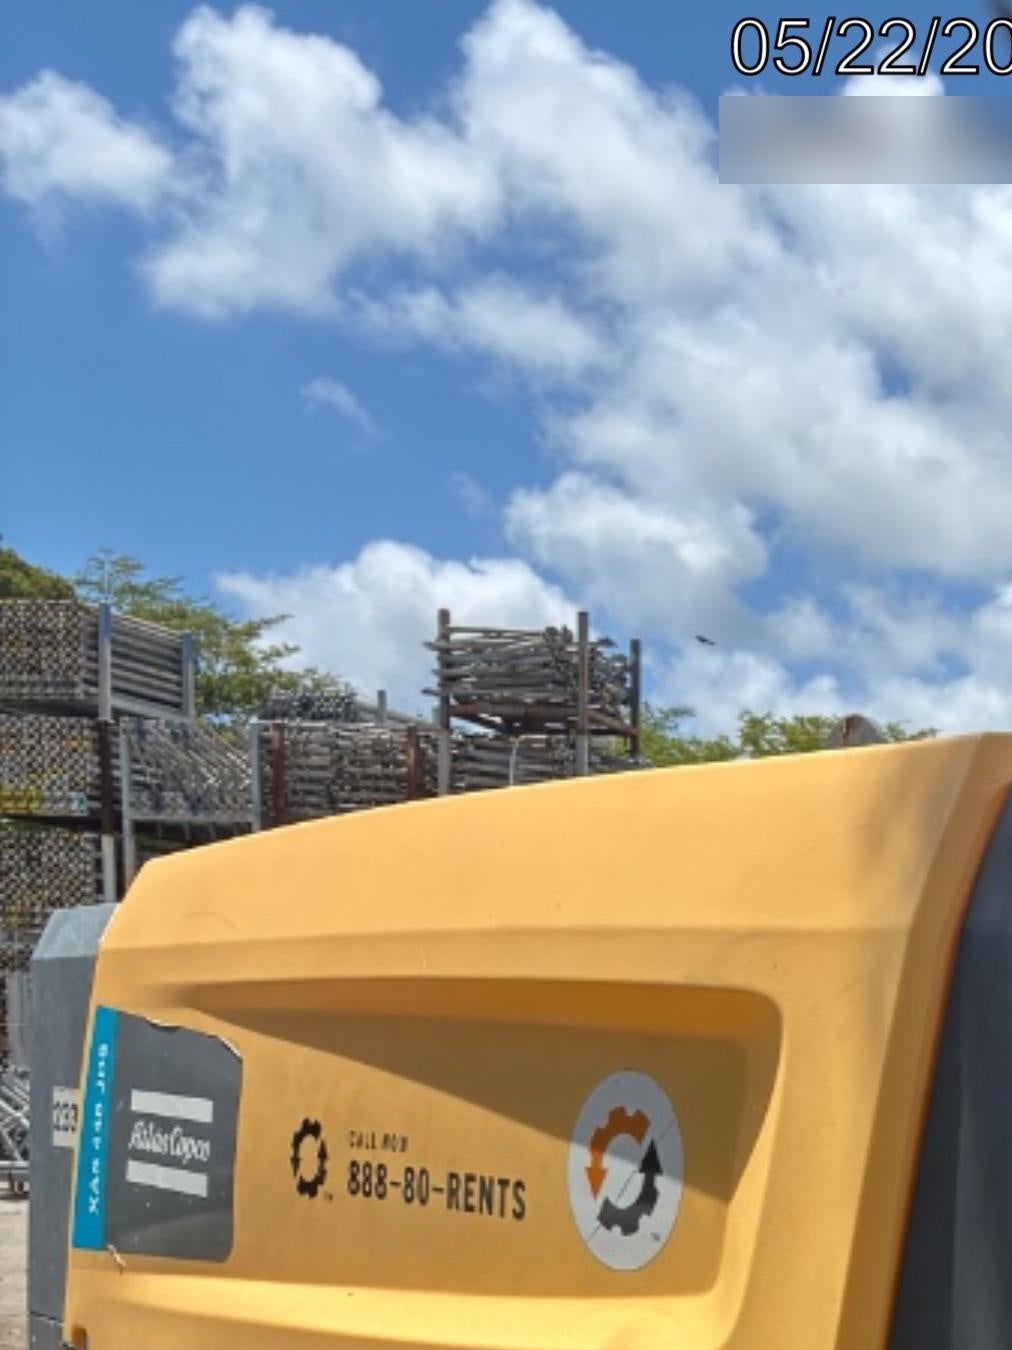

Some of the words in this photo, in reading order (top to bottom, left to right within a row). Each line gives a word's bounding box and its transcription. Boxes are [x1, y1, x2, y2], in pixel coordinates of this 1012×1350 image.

[128, 1120, 170, 1156] Atlas
[170, 1126, 210, 1164] Copco
[347, 1160, 527, 1221] 888-80-RENTS
